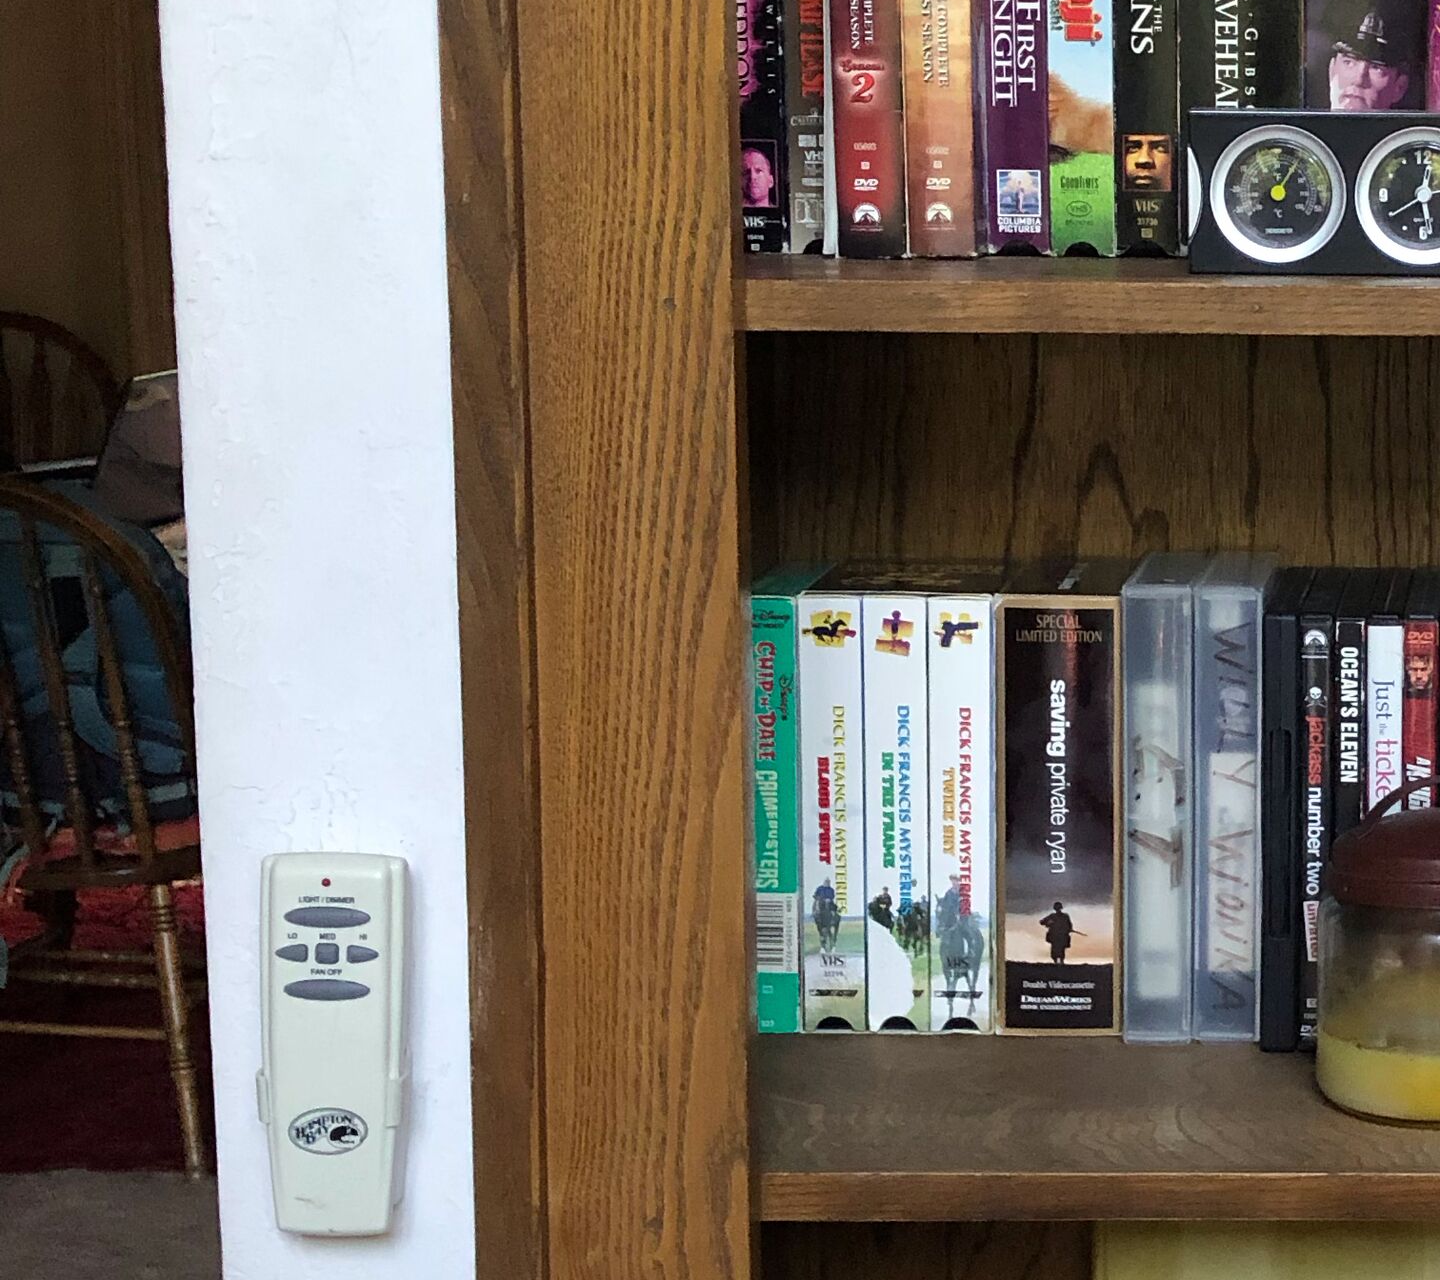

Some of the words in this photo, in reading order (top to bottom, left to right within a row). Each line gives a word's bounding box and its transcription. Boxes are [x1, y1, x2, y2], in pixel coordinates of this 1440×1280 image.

[849, 0, 863, 50] SEASON
[1153, 5, 1163, 33] THE
[764, 4, 778, 97] WILLIS
[922, 22, 935, 83] SEASON
[936, 4, 951, 88] COMPLETE
[1014, 0, 1042, 92] FIRST
[851, 73, 876, 103] 2
[1414, 150, 1433, 166] 12
[996, 216, 1042, 225] COLUMBIA
[998, 224, 1042, 234] PICTURES
[1134, 199, 1160, 213] VHS
[1015, 628, 1058, 643] LIMITED
[1060, 629, 1103, 644] EDITION
[1036, 613, 1082, 629] SPECIAL
[756, 640, 777, 689] CHIP
[1340, 646, 1359, 718] OCEAN'S
[1046, 679, 1071, 757] saving
[1372, 679, 1395, 720] Just
[756, 709, 779, 761] DALE
[831, 704, 846, 746] DICK
[897, 704, 912, 746] DICK
[958, 706, 973, 748] DICK
[1304, 714, 1326, 784] jackass
[881, 751, 896, 770] IN
[1340, 722, 1359, 783] ELEVEN
[816, 756, 832, 808] BLOOD
[832, 751, 846, 822] FRANCIS
[882, 774, 896, 808] THE
[898, 751, 912, 822] FRANCIS
[942, 767, 957, 820] TWICE
[959, 753, 973, 824] FRANCIS
[1045, 762, 1071, 826] private
[817, 812, 832, 865] SPORT
[882, 811, 896, 869] FRAME
[1306, 786, 1326, 856] number
[832, 826, 847, 916] MYSTERIES
[898, 826, 913, 916] MYSTERIES
[959, 828, 974, 918] MYSTERIES
[1045, 831, 1068, 874] ryan
[1306, 860, 1324, 895] two
[298, 895, 320, 904] LIGHT
[287, 932, 298, 940] LO
[319, 932, 336, 940] MED
[310, 968, 326, 976] FAN
[327, 968, 343, 976] OFF
